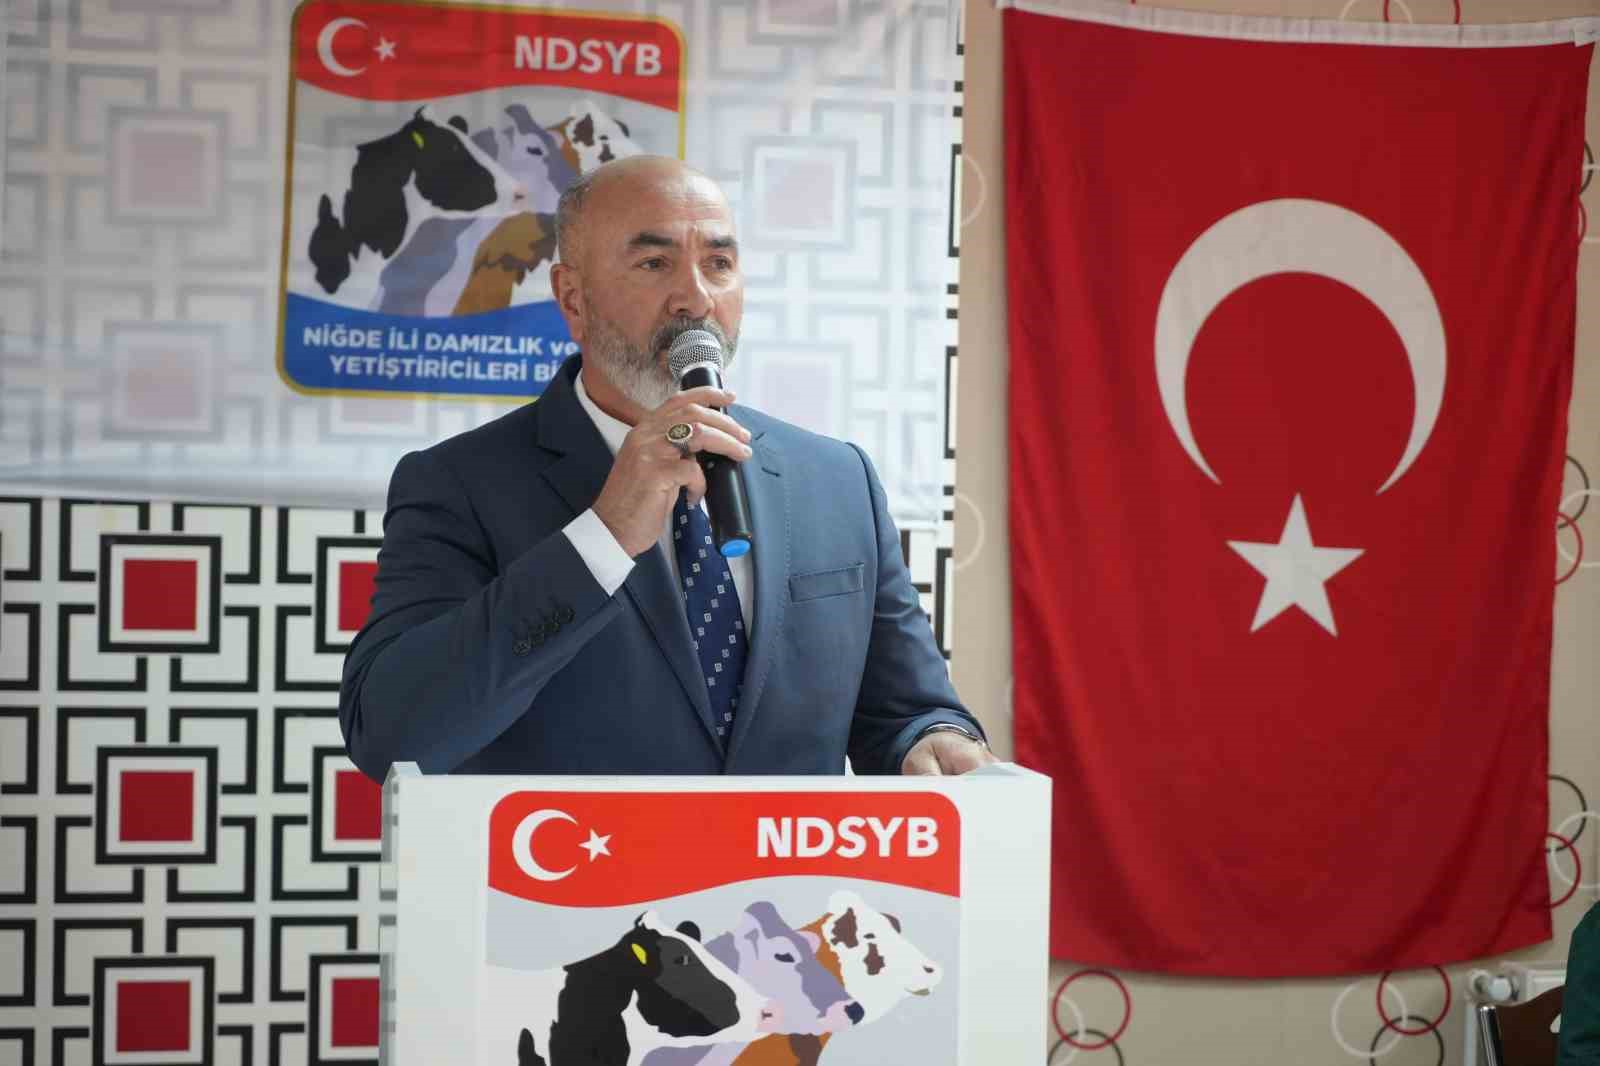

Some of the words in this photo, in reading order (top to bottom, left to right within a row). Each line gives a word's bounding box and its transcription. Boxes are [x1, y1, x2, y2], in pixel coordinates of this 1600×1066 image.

[514, 35, 662, 76] NDSYB
[303, 325, 382, 349] NİĞDE
[388, 327, 418, 350] İLİ
[424, 332, 543, 355] DAMIZLIK
[329, 353, 527, 381] YETİŞTİRİCİLERİ
[533, 360, 560, 381] Bİ
[756, 815, 940, 858] NDSYB
